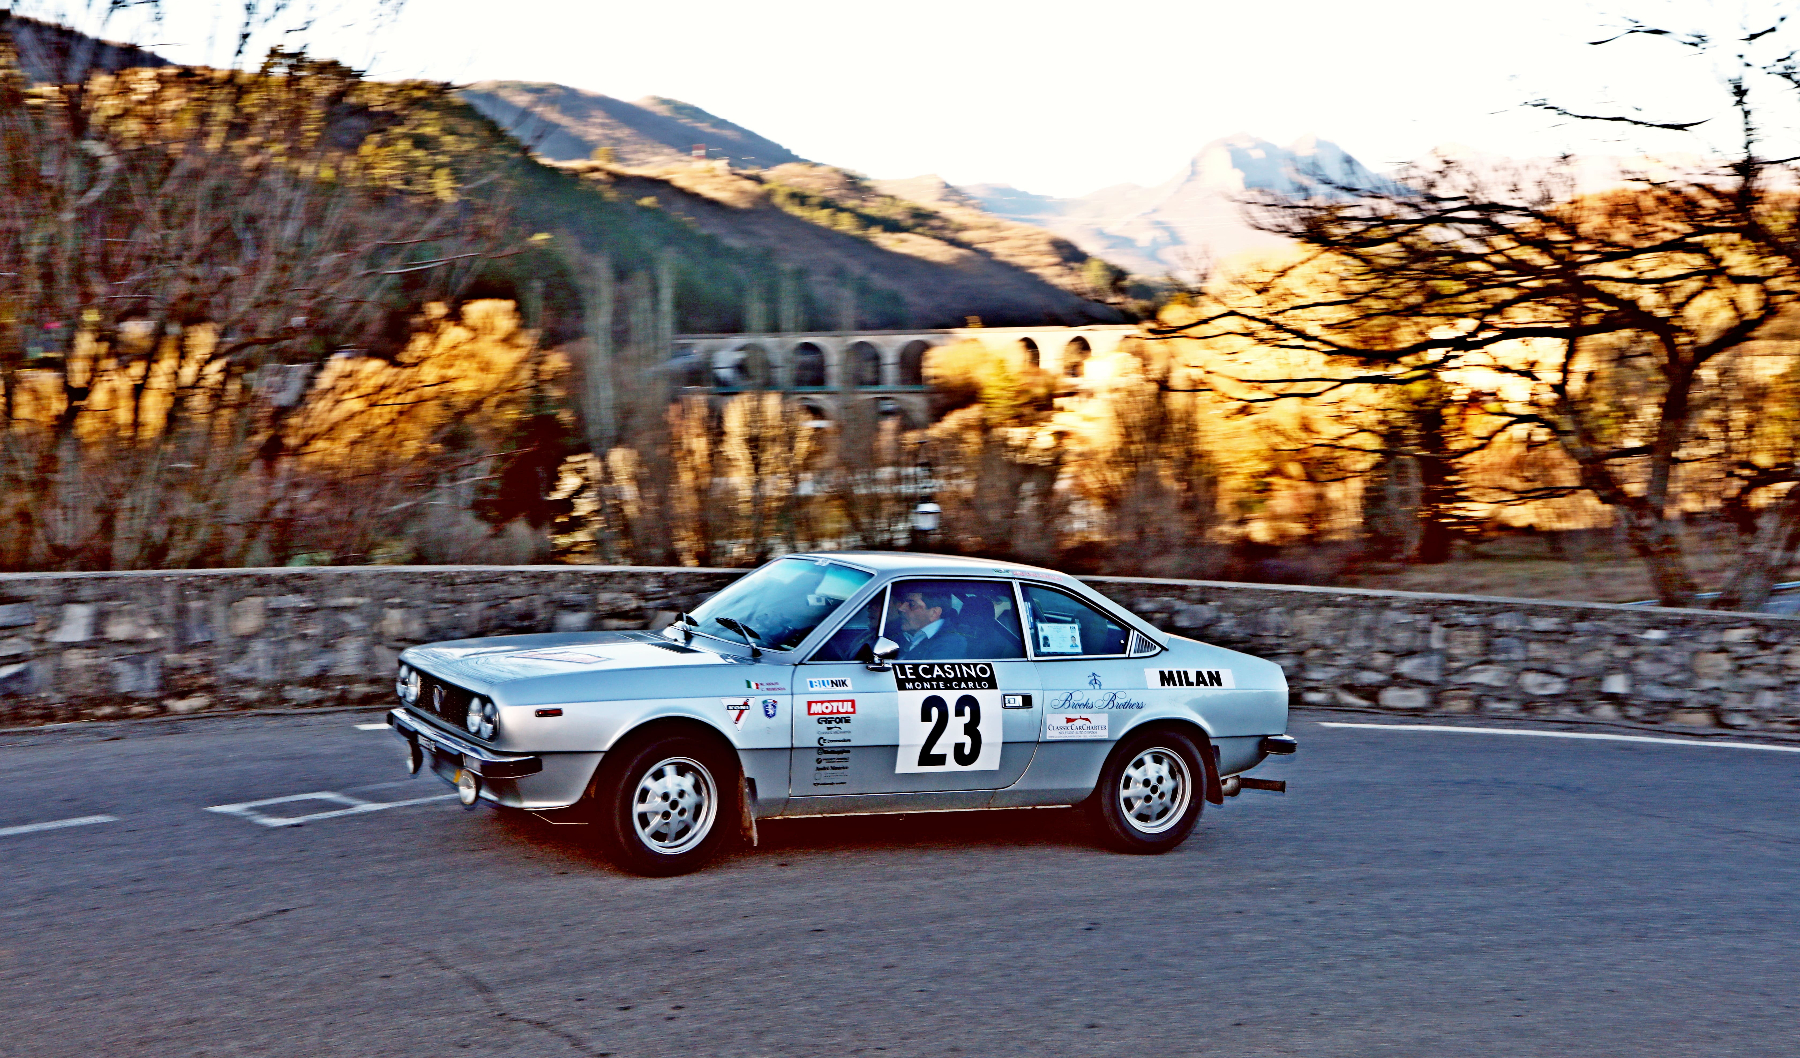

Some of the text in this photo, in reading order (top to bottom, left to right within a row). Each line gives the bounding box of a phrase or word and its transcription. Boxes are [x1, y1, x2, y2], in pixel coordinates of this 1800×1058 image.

[895, 663, 991, 679] LE CASINO
[1159, 670, 1223, 687] MILAN
[809, 679, 849, 688] BLUNIK
[1049, 689, 1147, 710] Brooks Brothers
[810, 702, 854, 714] MOTUL
[917, 694, 983, 767] 23
